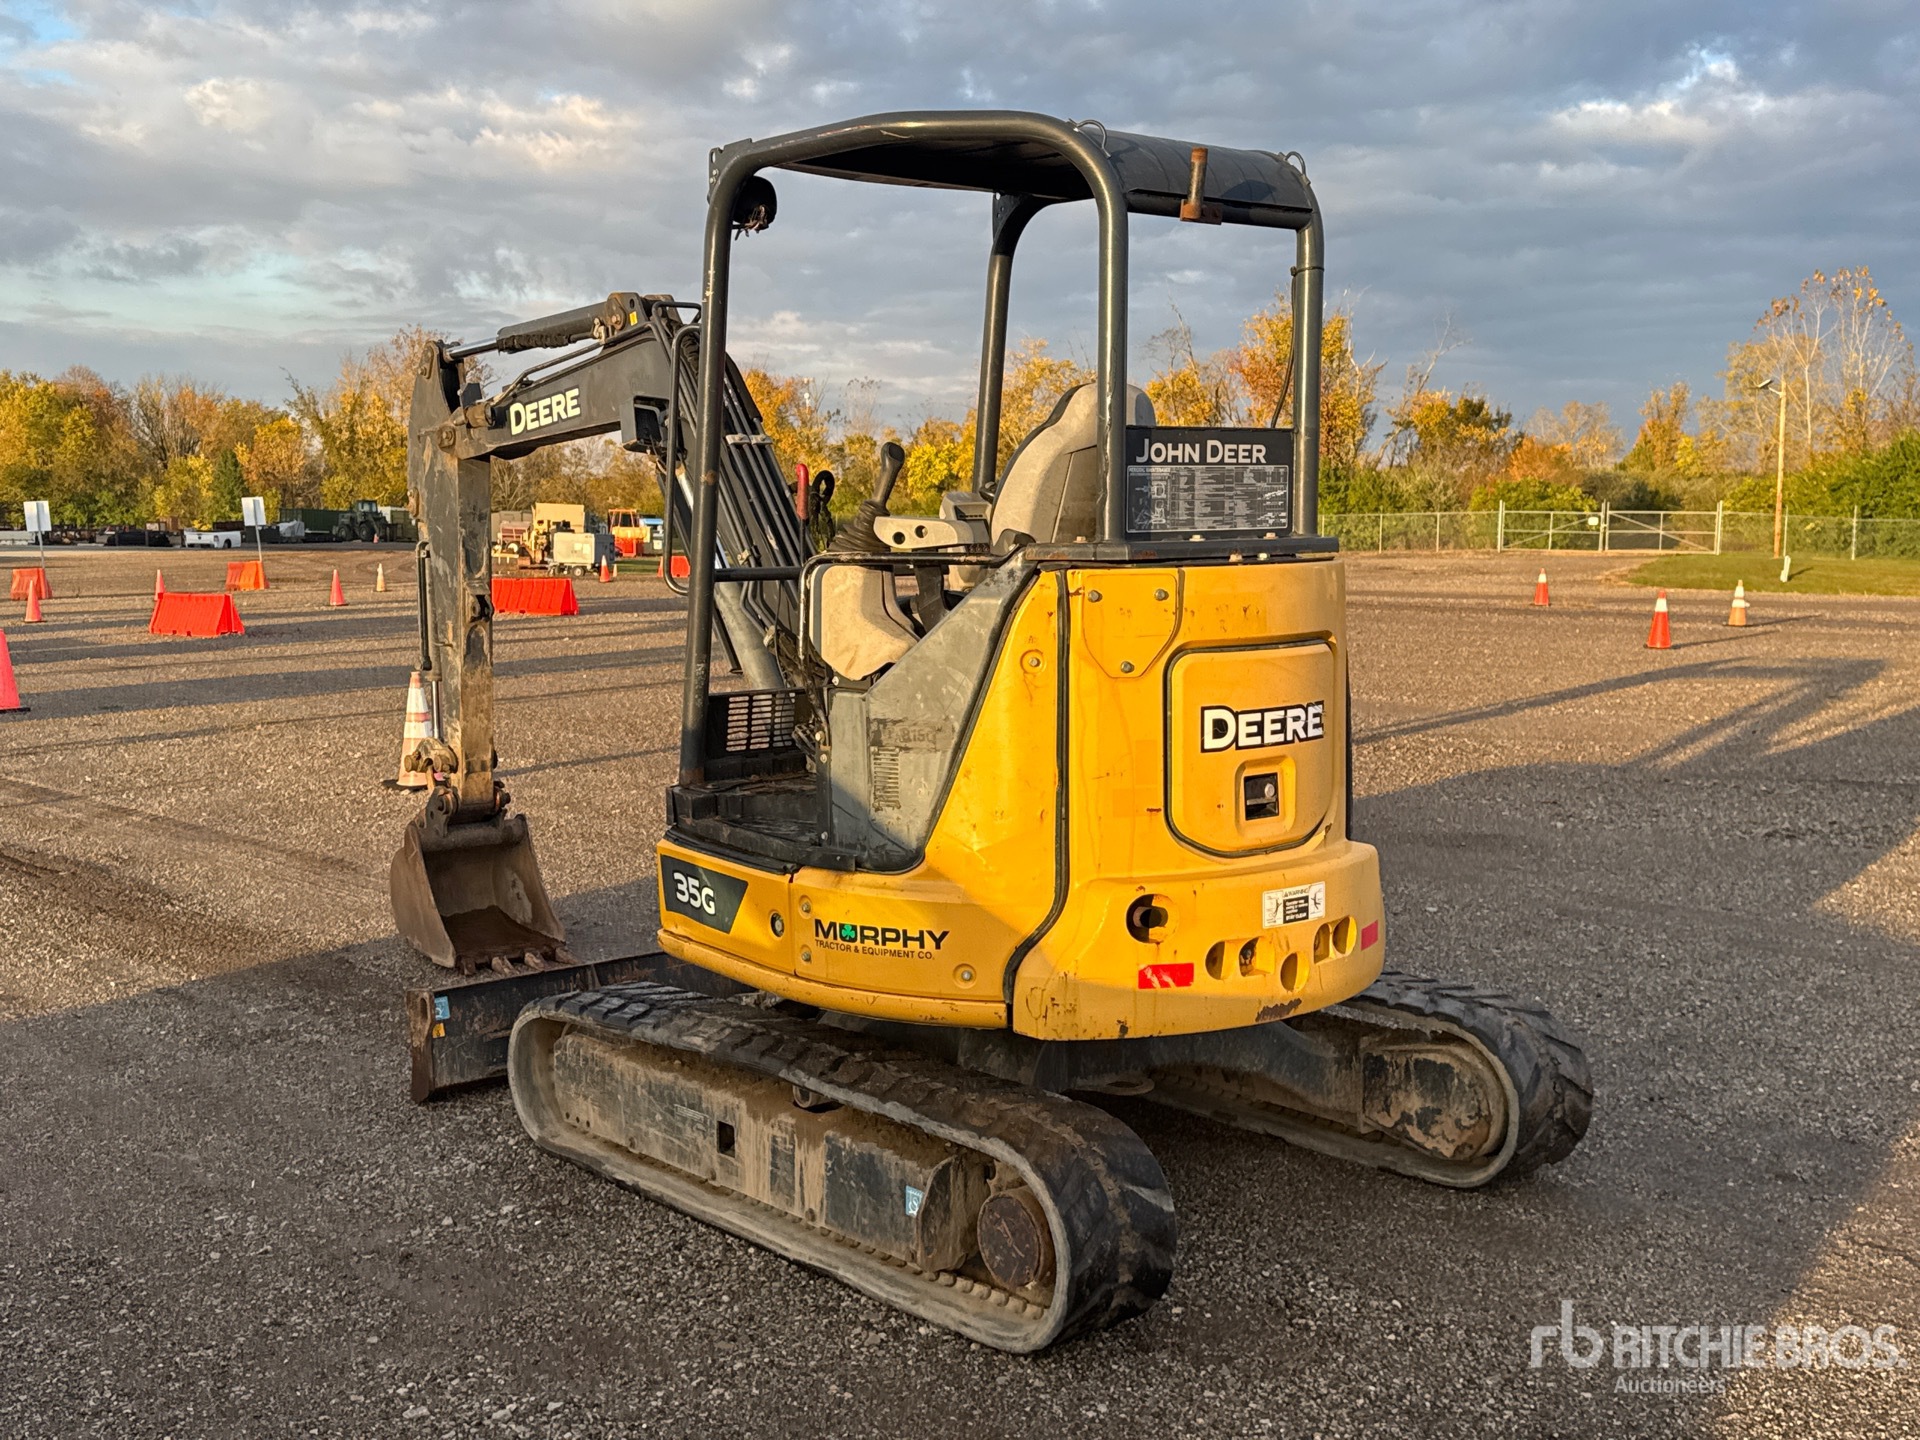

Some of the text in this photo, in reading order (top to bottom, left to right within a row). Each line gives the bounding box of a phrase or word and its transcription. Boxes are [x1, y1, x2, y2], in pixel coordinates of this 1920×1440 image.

[509, 388, 580, 435] DEERE
[1136, 438, 1267, 463] JOHN DEER
[1202, 703, 1324, 751] DEERE
[673, 872, 716, 915] 35G
[814, 918, 950, 950] MURPHY
[814, 939, 852, 953] TRACTOR
[853, 945, 860, 954] &
[862, 946, 915, 958] EQUIPMENT
